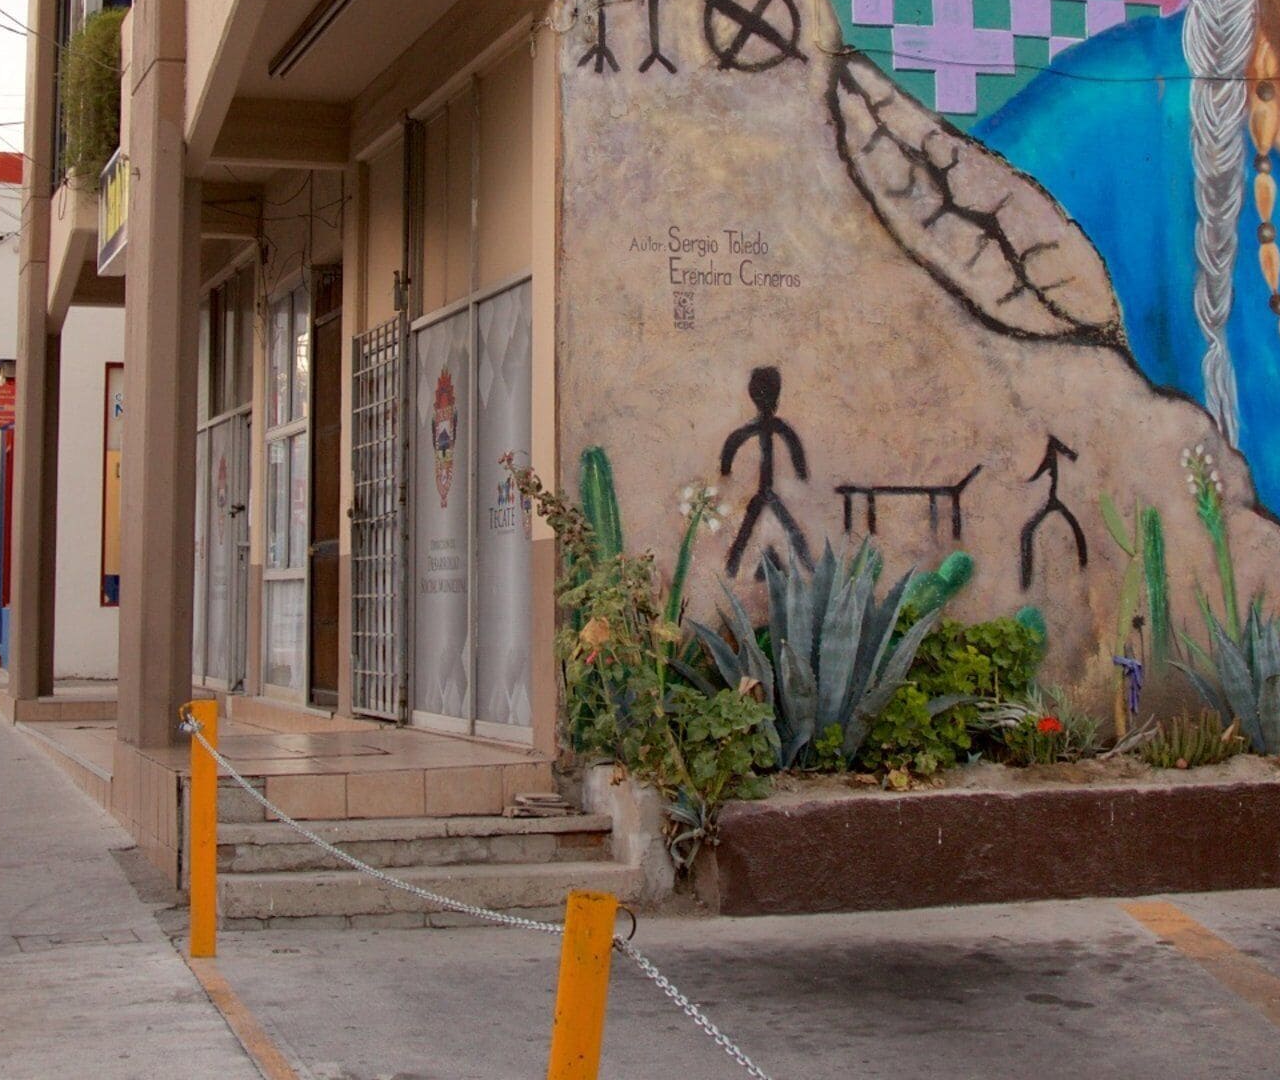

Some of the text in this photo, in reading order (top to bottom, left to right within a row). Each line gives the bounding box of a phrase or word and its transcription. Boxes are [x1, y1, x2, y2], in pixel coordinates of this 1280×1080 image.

[668, 226, 718, 257] Sergio
[723, 229, 768, 255] Toledo
[488, 506, 516, 530] TECATE
